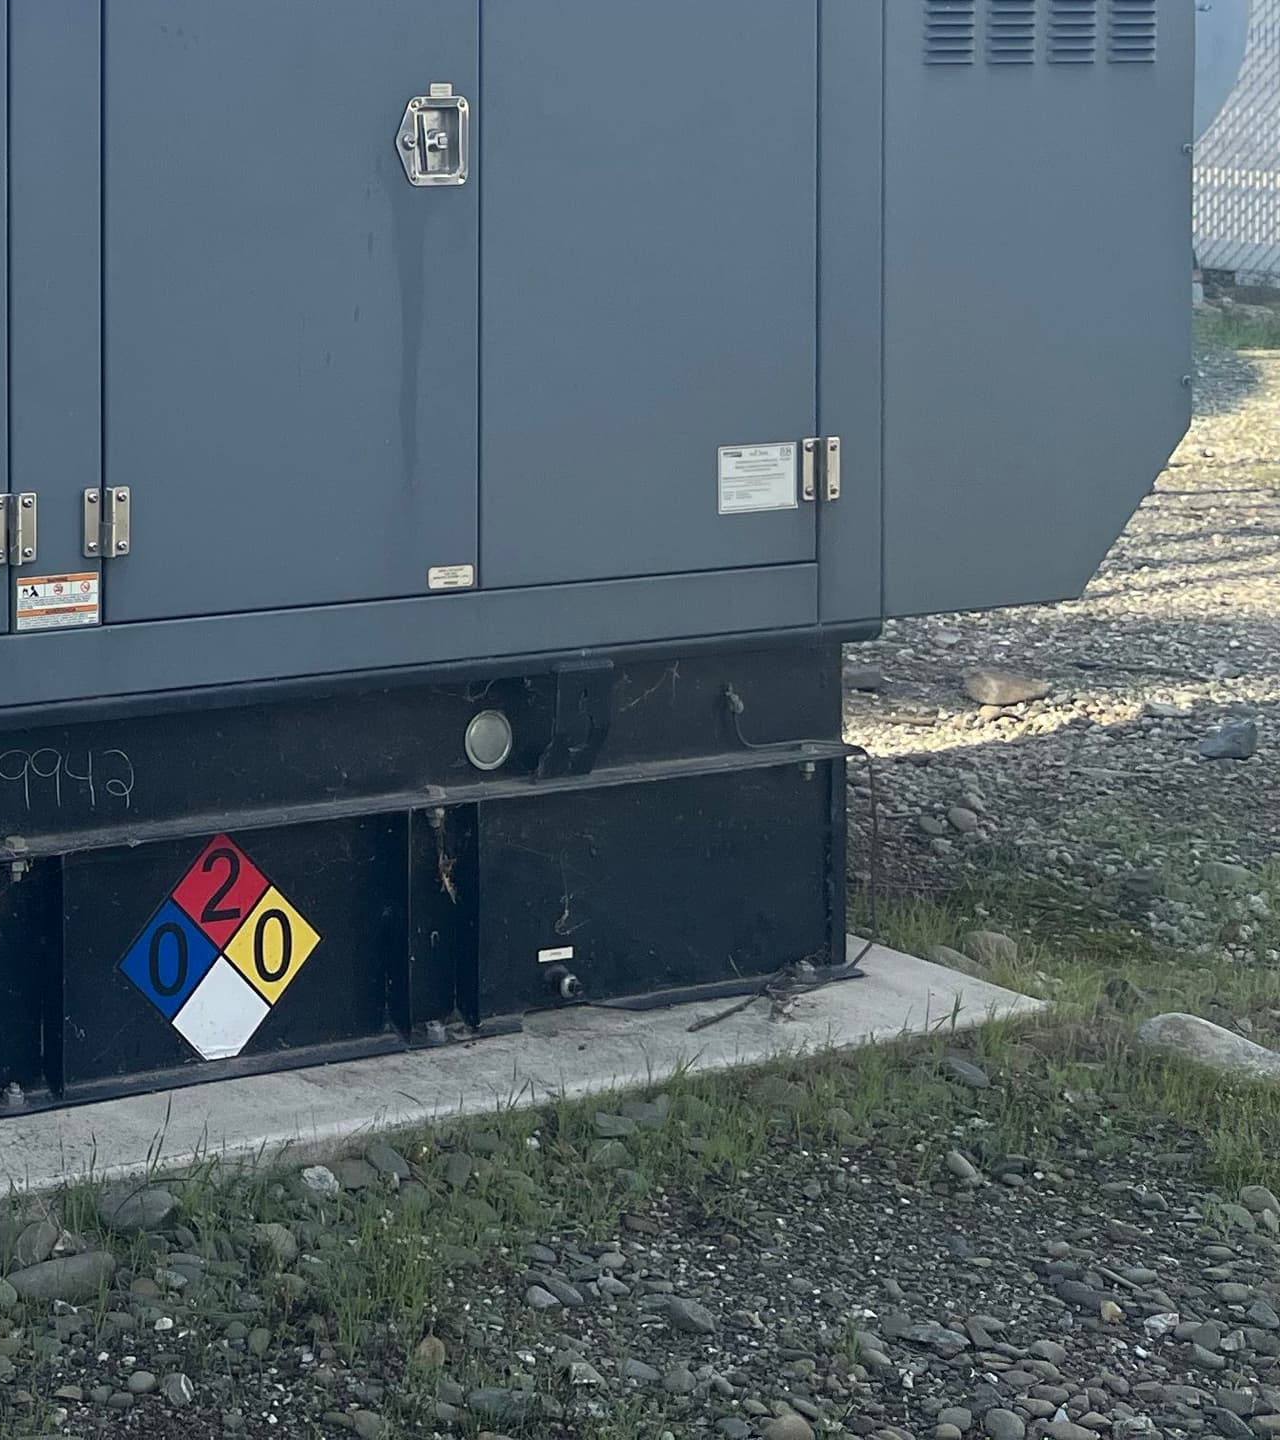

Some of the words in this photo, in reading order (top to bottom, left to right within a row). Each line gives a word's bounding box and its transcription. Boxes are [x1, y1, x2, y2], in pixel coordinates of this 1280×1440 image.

[201, 847, 240, 924] 2
[148, 921, 188, 997] 0
[253, 908, 292, 982] 0
